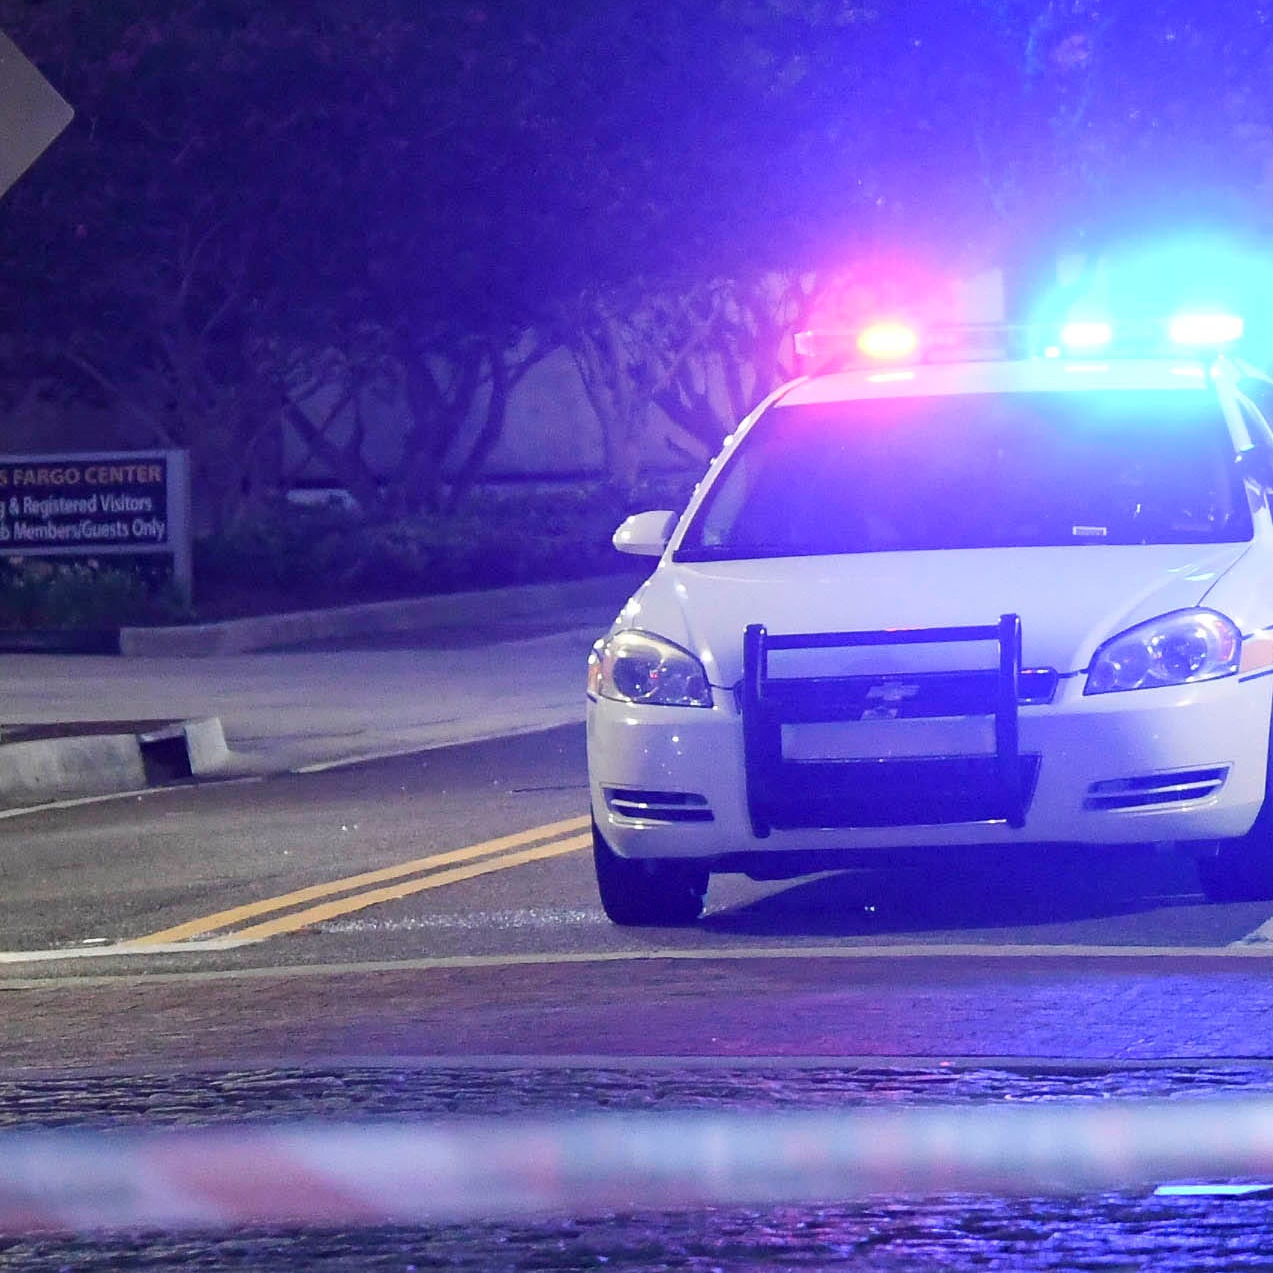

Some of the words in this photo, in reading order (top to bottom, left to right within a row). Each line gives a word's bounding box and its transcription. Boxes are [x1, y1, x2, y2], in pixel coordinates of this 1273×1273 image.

[13, 467, 80, 486] FARGO
[84, 464, 161, 485] CENTER
[8, 496, 19, 515] &
[23, 494, 97, 519] Registered
[100, 493, 152, 513] Visitors
[13, 519, 129, 541] Members/Guests
[131, 518, 165, 543] Only
